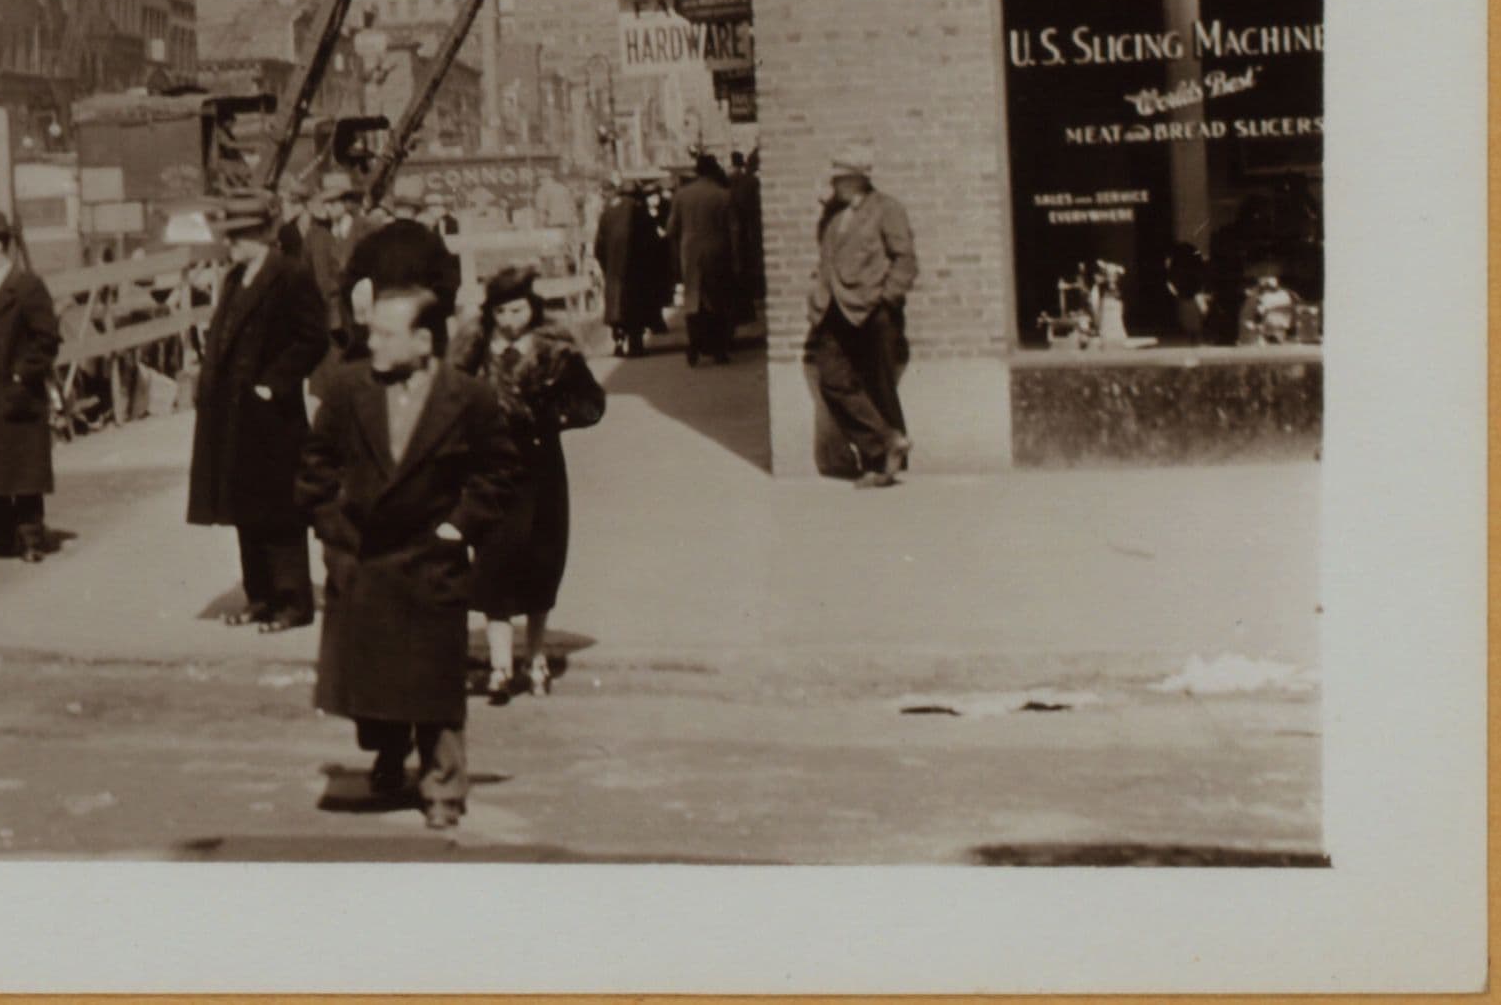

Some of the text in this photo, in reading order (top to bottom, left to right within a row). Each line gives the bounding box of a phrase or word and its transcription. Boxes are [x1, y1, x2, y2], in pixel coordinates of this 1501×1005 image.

[625, 22, 747, 66] HARDWARE
[1071, 24, 1185, 65] SLICING
[1064, 124, 1123, 145] MEAT
[1153, 120, 1228, 142] BREAD
[1233, 115, 1325, 139] SLICERS
